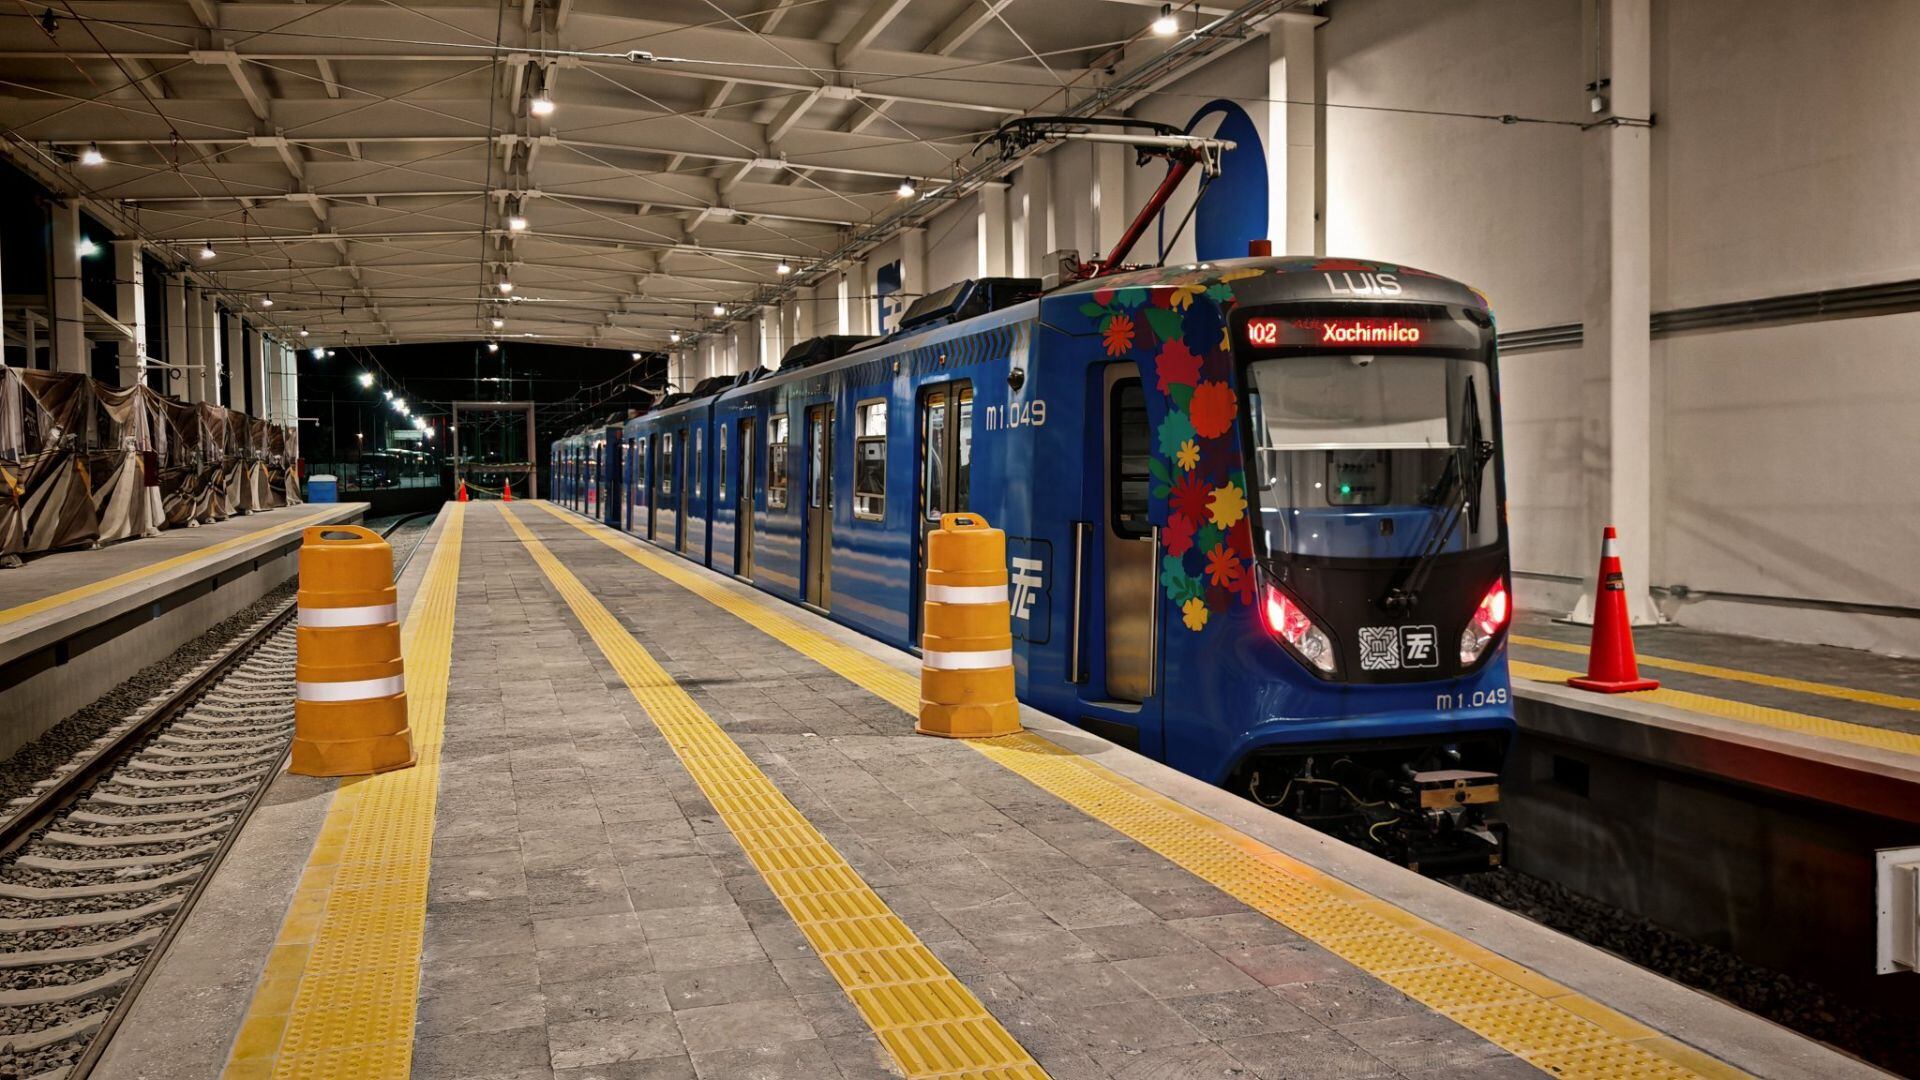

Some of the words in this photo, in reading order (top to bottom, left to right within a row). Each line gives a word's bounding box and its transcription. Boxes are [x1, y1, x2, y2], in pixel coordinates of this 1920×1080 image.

[1324, 272, 1402, 296] LUIS
[1322, 322, 1420, 342] Xochimilco
[986, 399, 1047, 431] m1.049
[1436, 687, 1508, 711] m1.049
